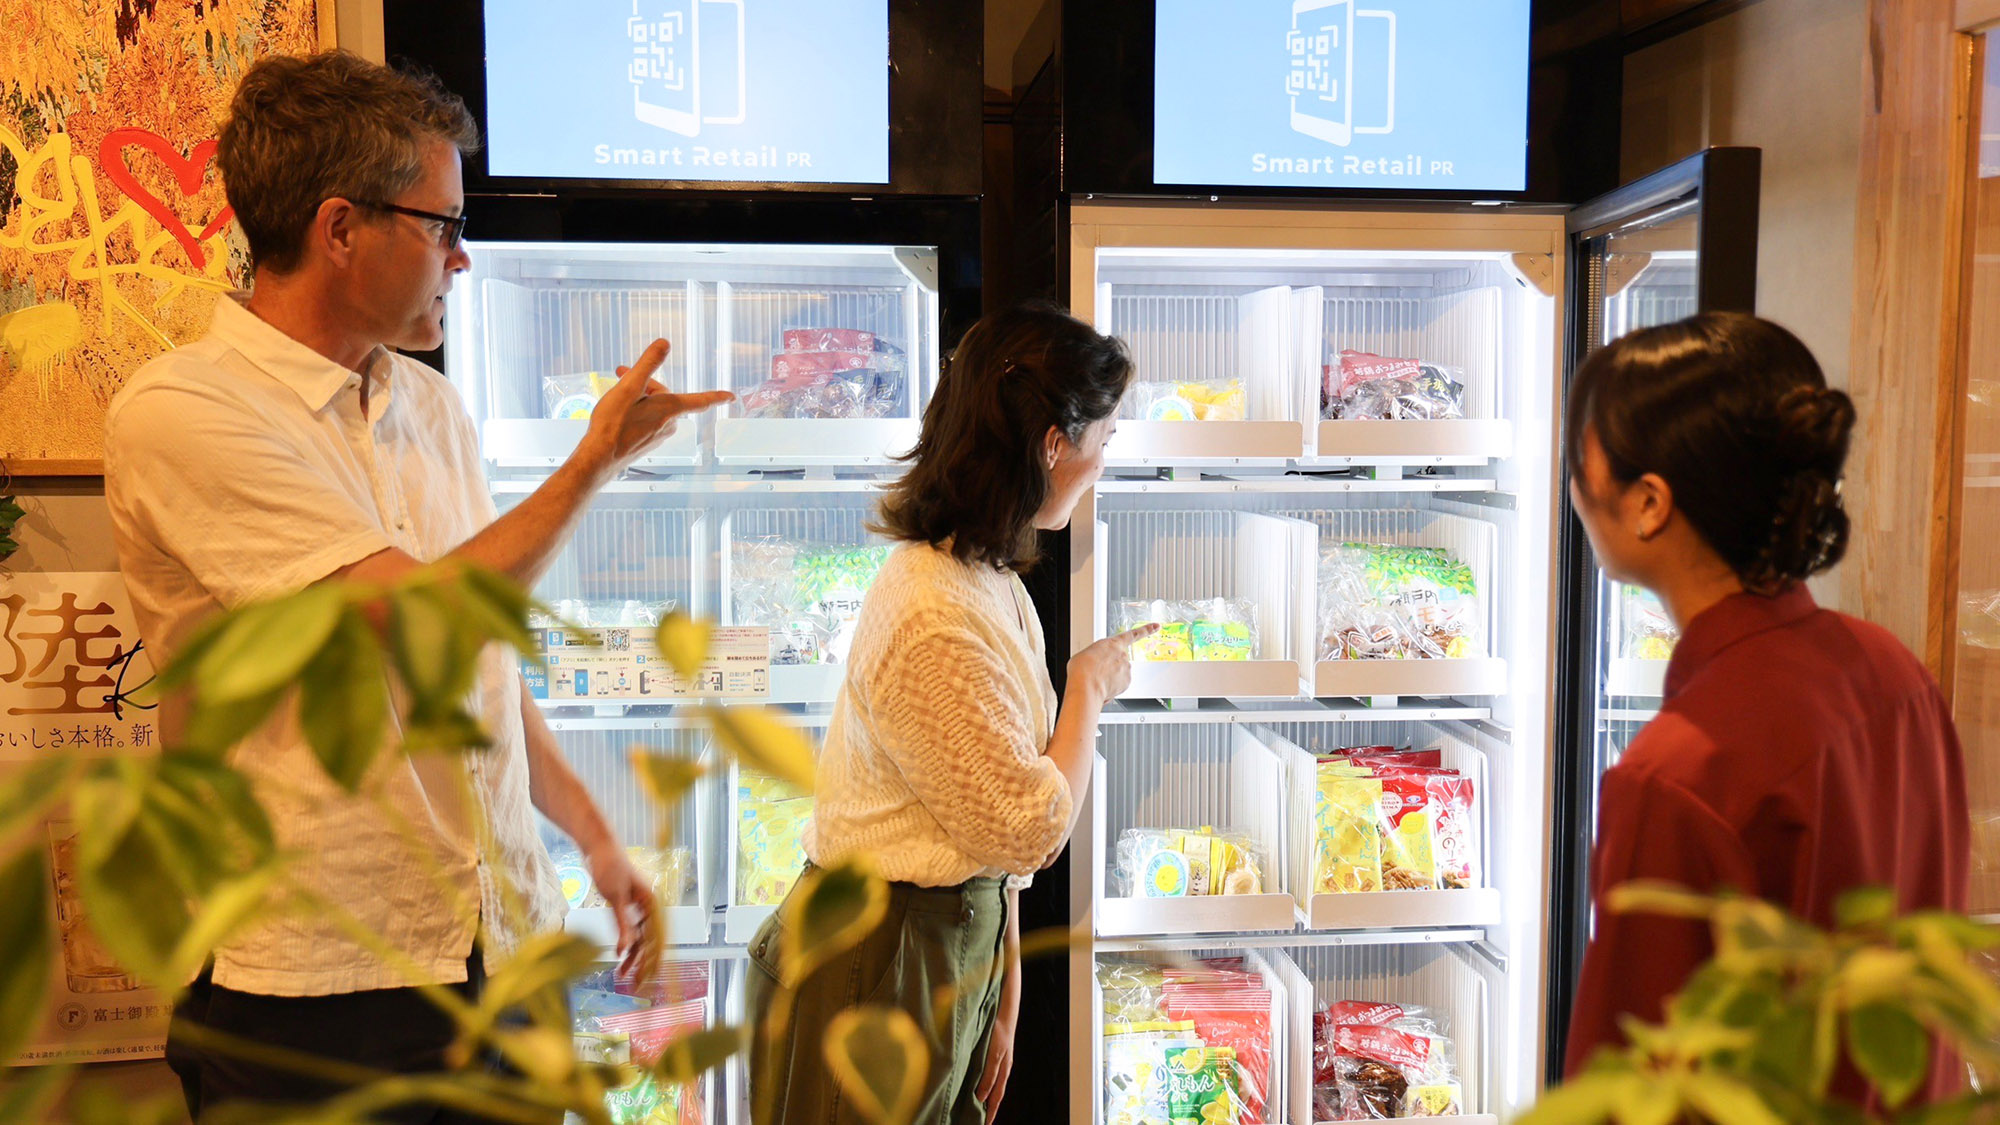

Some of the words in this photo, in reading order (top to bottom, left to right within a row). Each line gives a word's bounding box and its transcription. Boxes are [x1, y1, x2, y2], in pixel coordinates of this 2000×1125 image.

[594, 144, 683, 167] Smart
[692, 146, 778, 168] Retail
[786, 152, 812, 168] PR
[1251, 153, 1334, 175] Smart
[1343, 155, 1422, 176] Retail
[1430, 161, 1454, 176] PR
